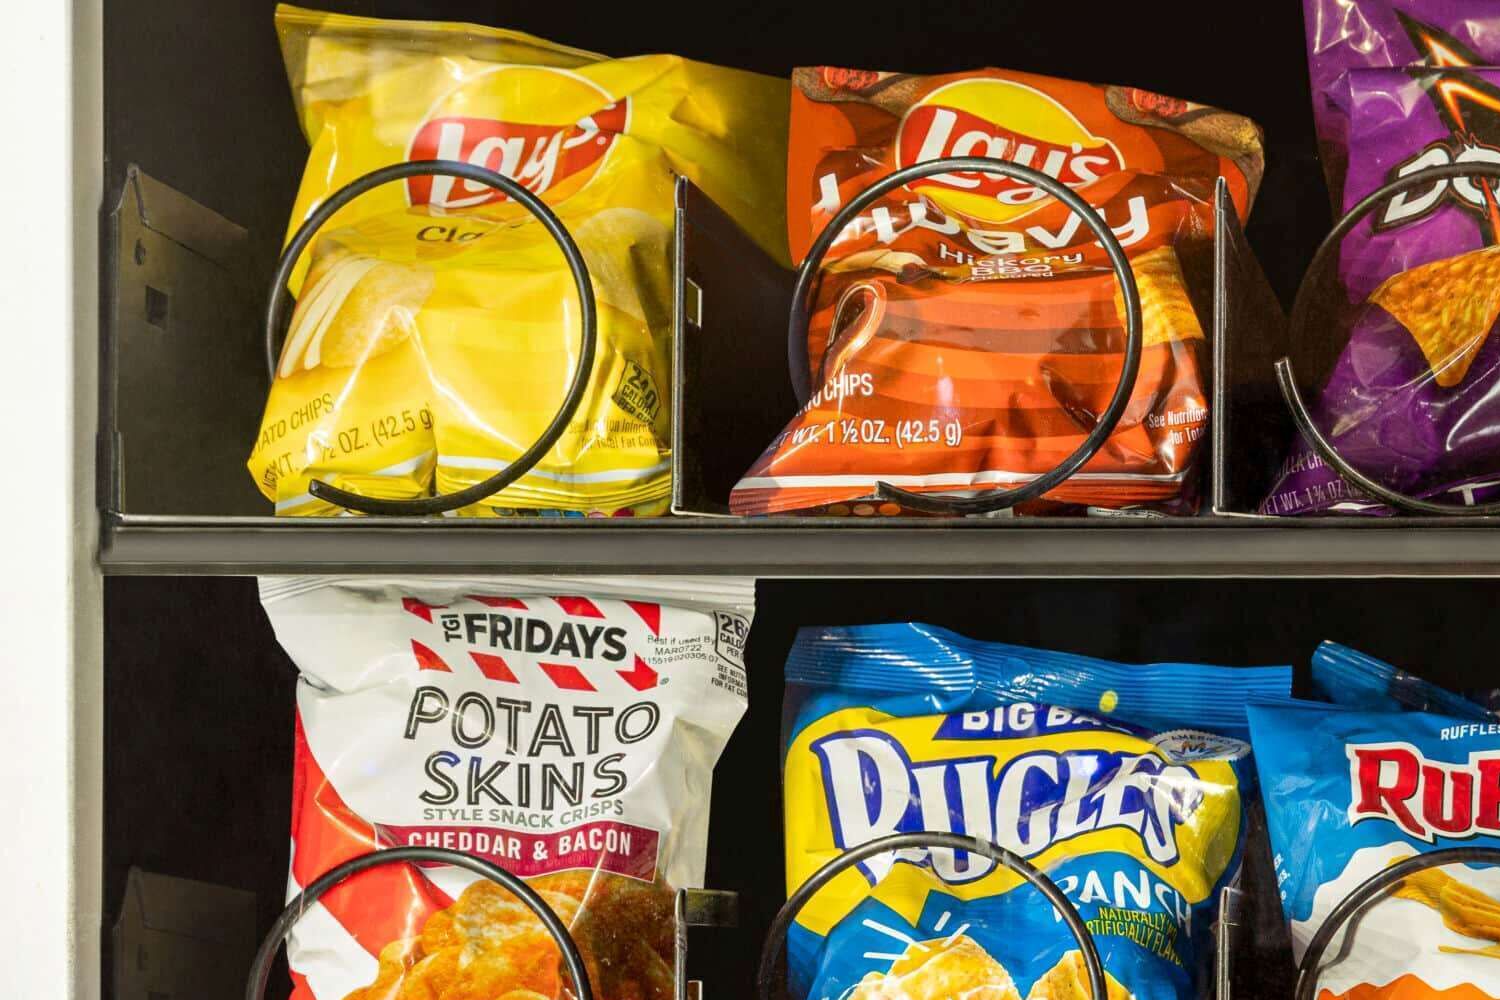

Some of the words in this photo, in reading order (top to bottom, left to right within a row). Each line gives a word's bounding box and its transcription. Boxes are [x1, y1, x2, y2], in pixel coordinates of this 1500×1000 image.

[913, 108, 1110, 207] Lay's
[939, 243, 1084, 266] Hickory
[824, 373, 874, 400] CHIPS
[290, 393, 335, 431] CHIPS
[1148, 413, 1166, 429] See
[337, 428, 368, 454] OZ.
[371, 410, 416, 447] (42.5
[861, 419, 890, 443] OZ.
[896, 418, 940, 448] (42.5
[945, 419, 962, 447] g)
[443, 615, 462, 644] TGI
[462, 612, 628, 663] FRIDAYS
[404, 686, 661, 758] POTATO
[419, 750, 628, 811] SKINS
[423, 806, 484, 822] STYLE
[500, 811, 554, 829] SNACK
[560, 800, 625, 827] CRISPS
[817, 736, 1205, 888] BUGLES
[408, 831, 522, 861] CHEDDAR
[533, 838, 549, 861] &
[557, 829, 632, 858] BACON
[1053, 869, 1192, 938] RANCH
[1099, 907, 1167, 932] NATURALLY
